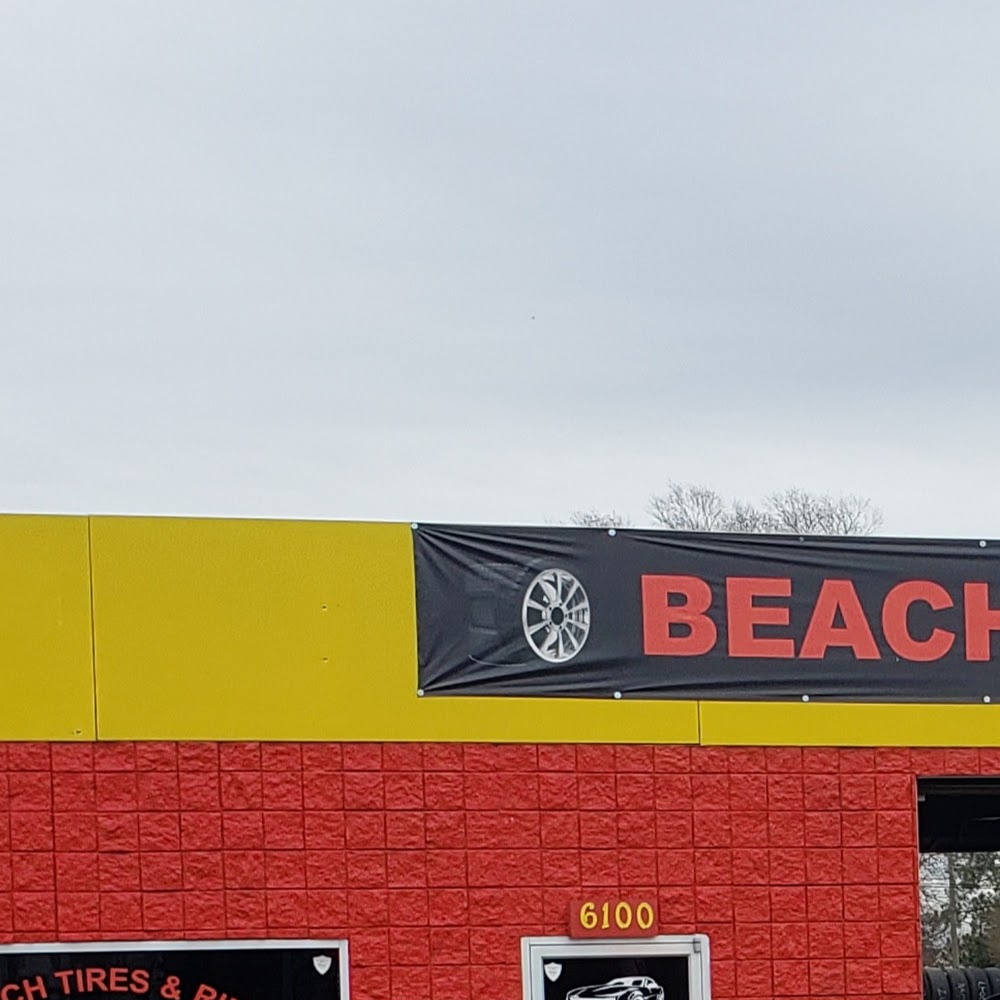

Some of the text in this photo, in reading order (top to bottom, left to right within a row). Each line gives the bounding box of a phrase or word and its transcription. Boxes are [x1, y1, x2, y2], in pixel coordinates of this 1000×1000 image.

[580, 902, 654, 929] 6100
[54, 968, 150, 994] TIRES
[160, 975, 181, 1000] &
